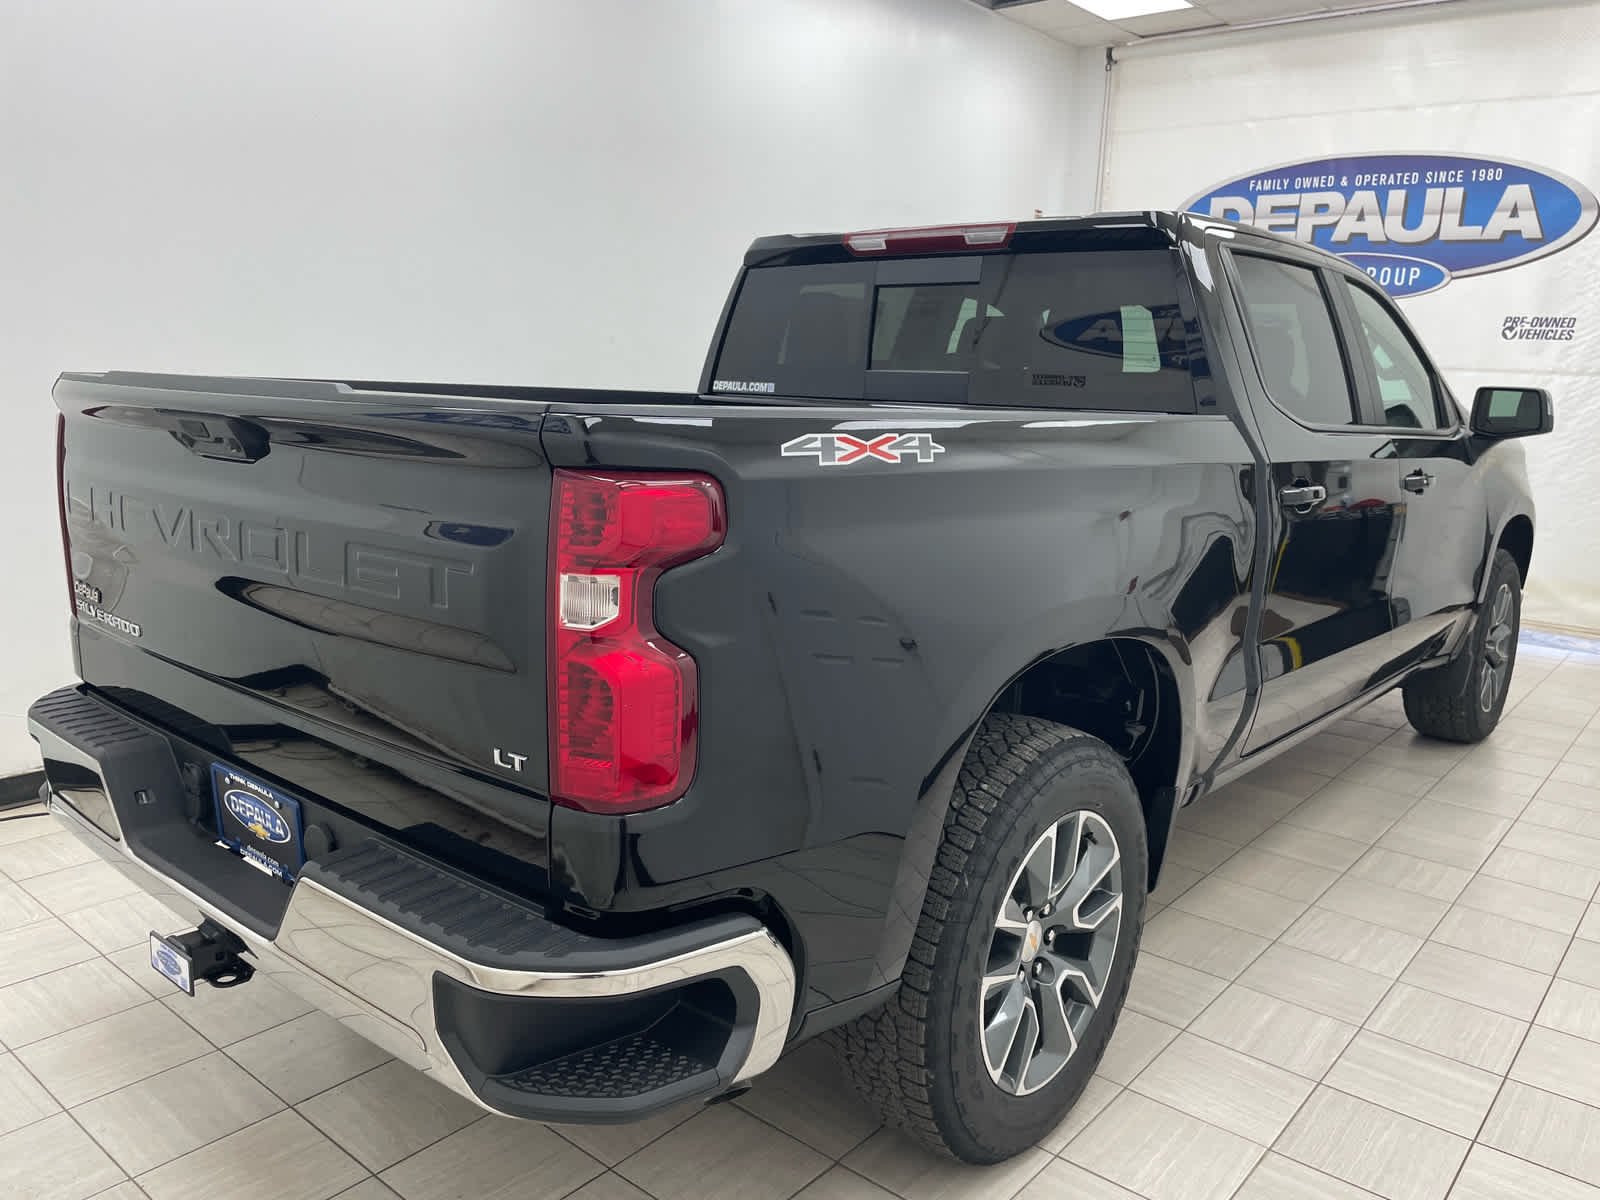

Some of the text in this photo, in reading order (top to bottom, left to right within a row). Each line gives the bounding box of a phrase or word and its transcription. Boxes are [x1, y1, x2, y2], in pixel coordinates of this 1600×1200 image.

[1249, 168, 1503, 191] FAMILY OWNED & OPERATED SINCE 1980
[1209, 183, 1545, 245] DEPAULA
[1366, 266, 1421, 287] ROUP
[1503, 316, 1577, 329] PRE-OWNED
[1518, 328, 1575, 341] VEHICLES
[712, 380, 767, 393] DEPAULA.COM
[77, 599, 142, 637] SILVERADO
[493, 748, 528, 772] LT
[229, 794, 286, 839] DEPAULA
